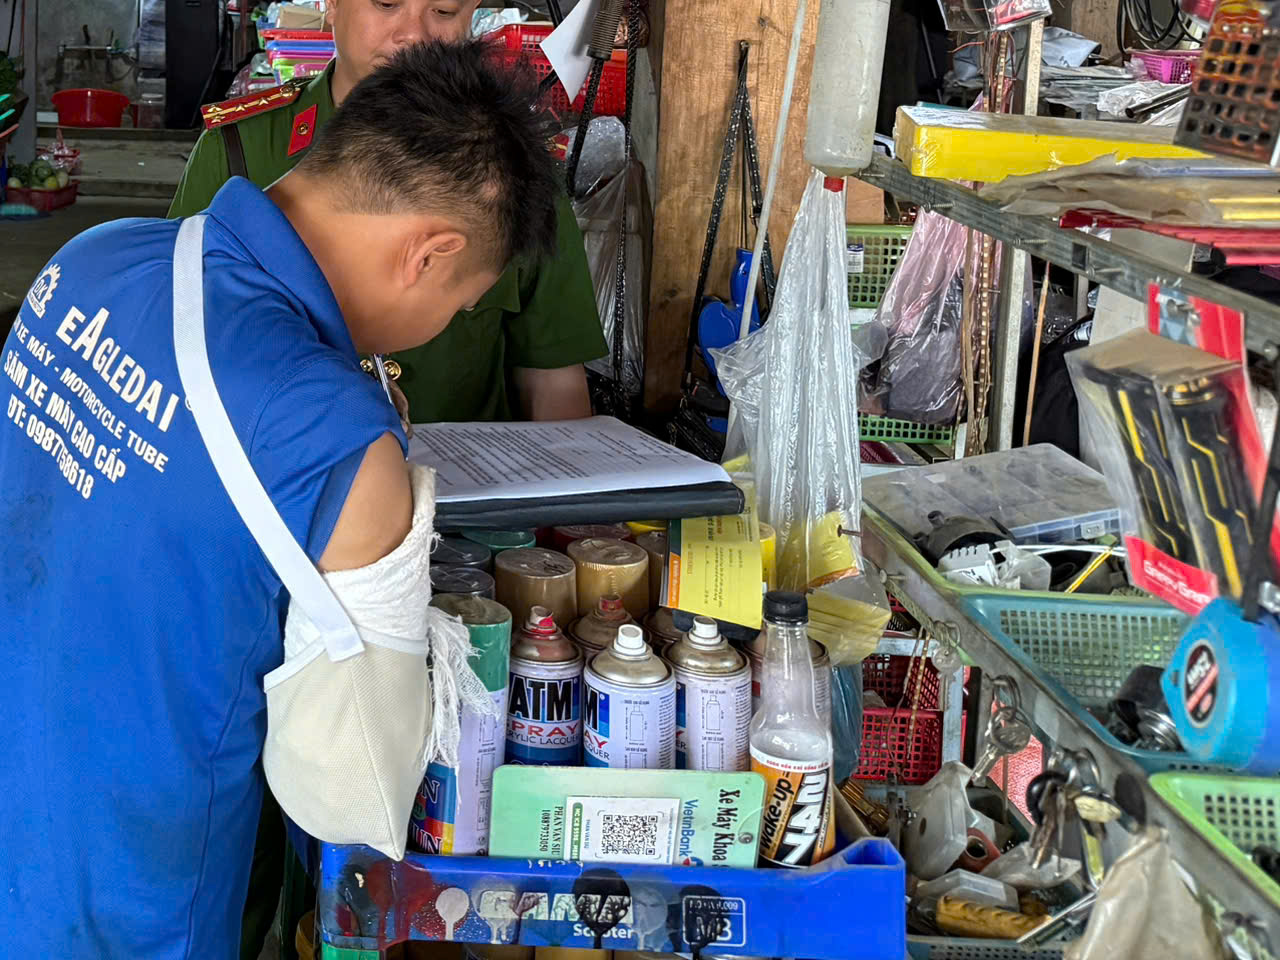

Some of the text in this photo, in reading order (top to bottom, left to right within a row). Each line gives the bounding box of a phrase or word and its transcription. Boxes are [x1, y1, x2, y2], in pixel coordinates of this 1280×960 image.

[56, 306, 180, 433] EAGLEDAI
[25, 373, 48, 408] XE
[45, 391, 76, 434] MÁY
[71, 420, 95, 459] CAO
[94, 446, 127, 484] CẤP
[26, 335, 56, 367] MÁY
[60, 367, 126, 440] MOTORCYCLE
[127, 429, 169, 473] TUBE
[508, 720, 578, 738] PRAY
[509, 675, 573, 722] ATM
[540, 734, 579, 745] LACQUE
[679, 799, 699, 857] VietinBank
[711, 789, 740, 863] Xe Máy Khoa
